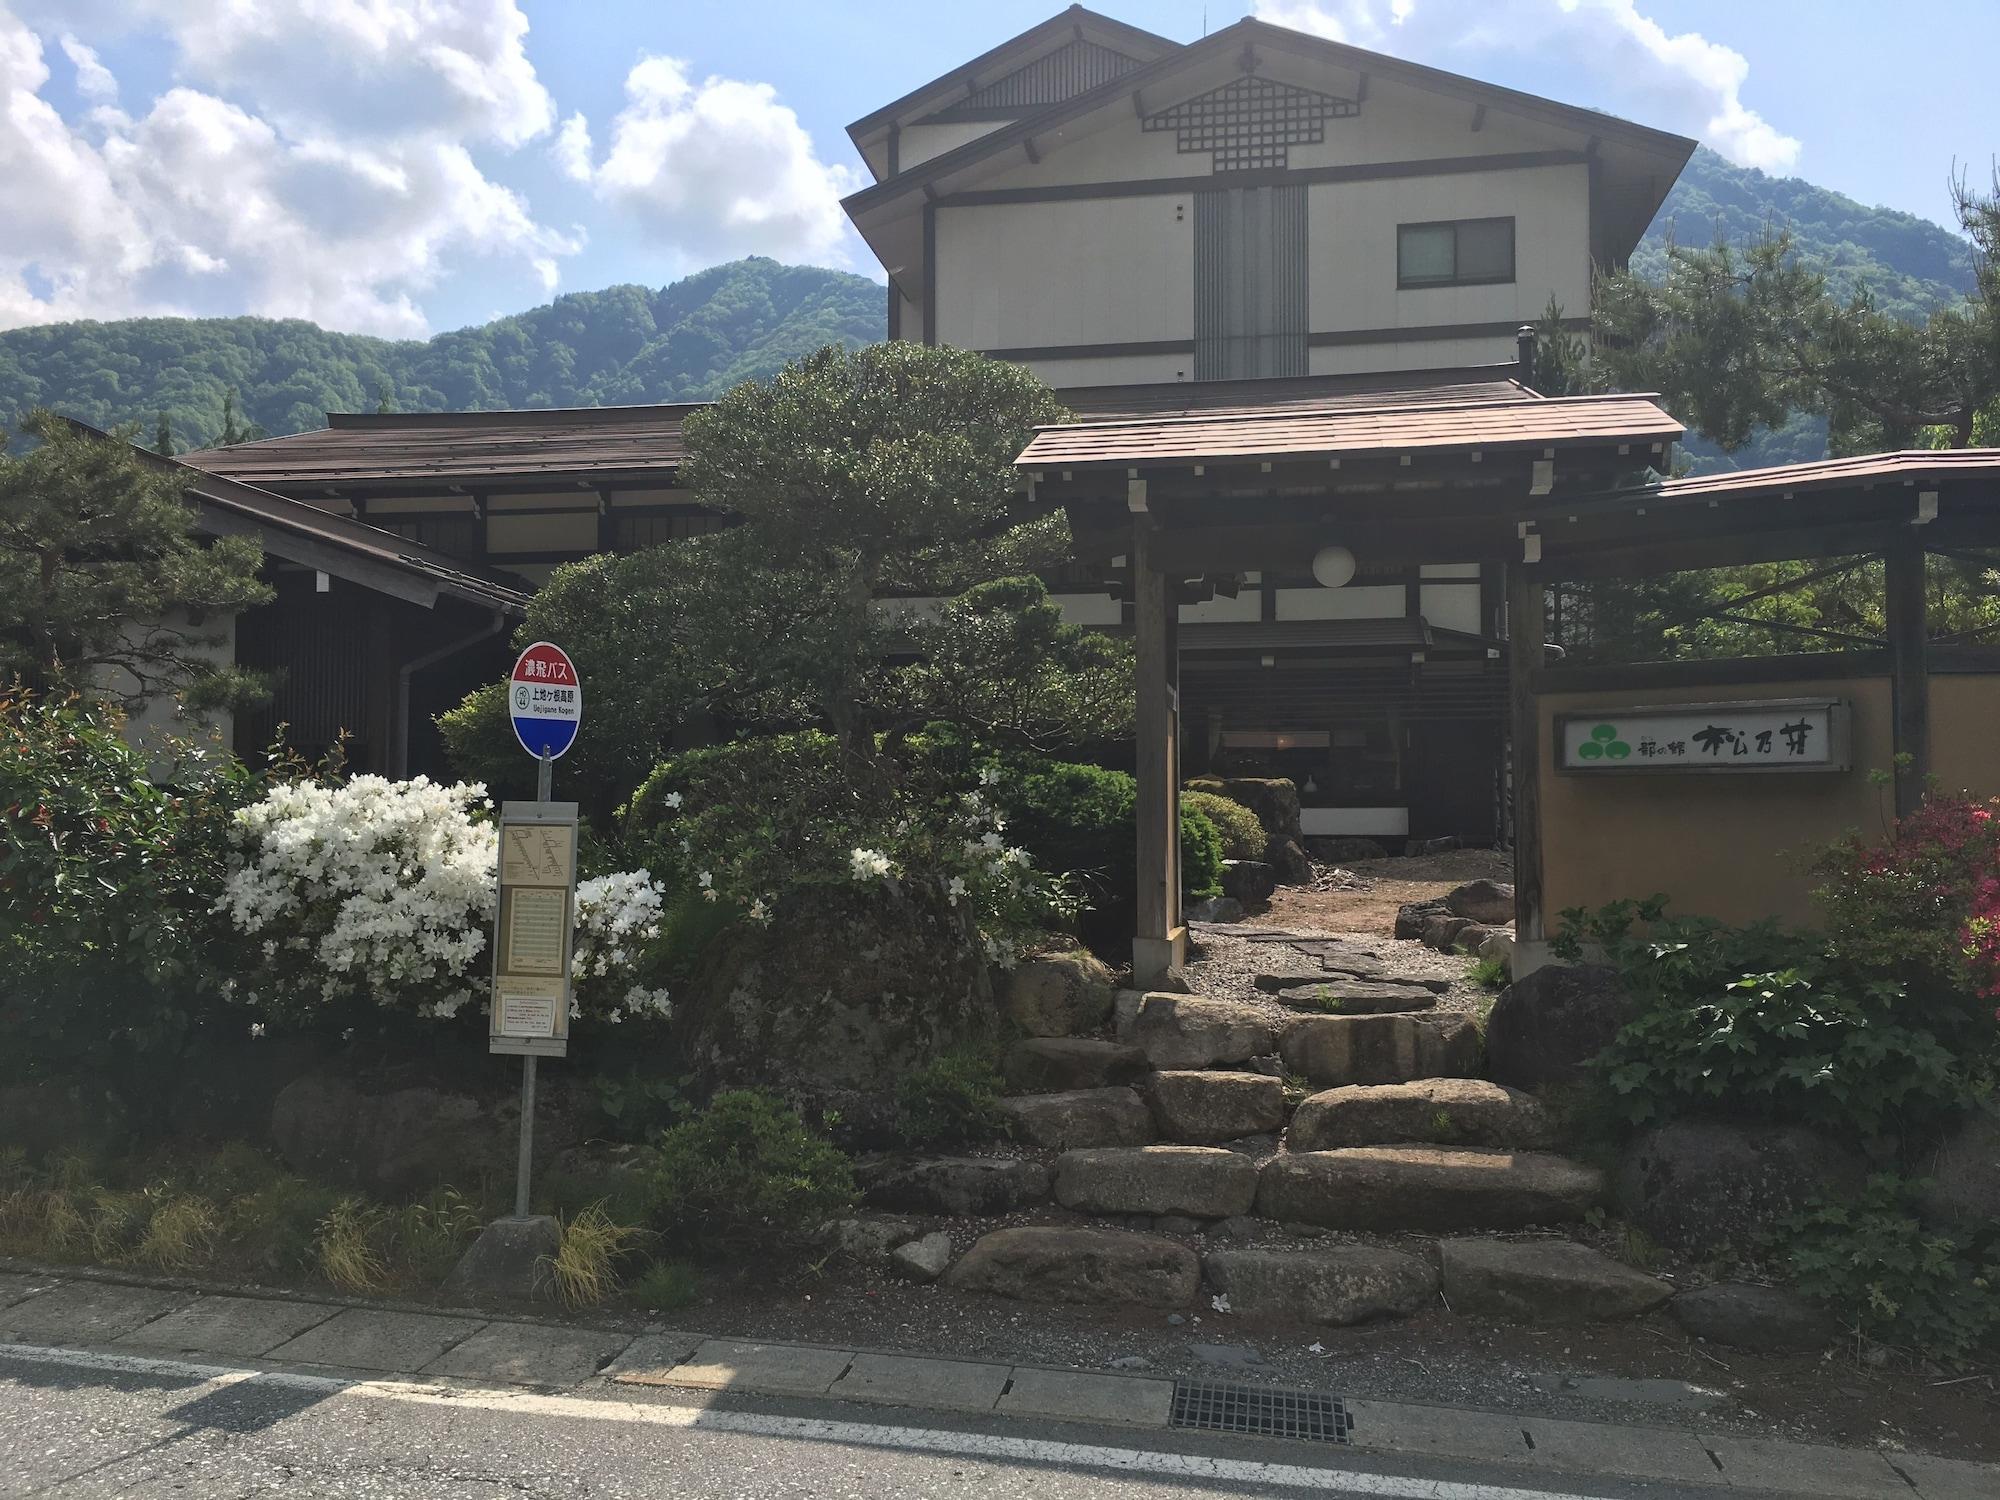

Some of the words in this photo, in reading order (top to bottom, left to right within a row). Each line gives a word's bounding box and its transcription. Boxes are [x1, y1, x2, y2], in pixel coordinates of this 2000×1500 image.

[525, 659, 568, 680] 濃飛バス
[558, 707, 575, 715] Kogen
